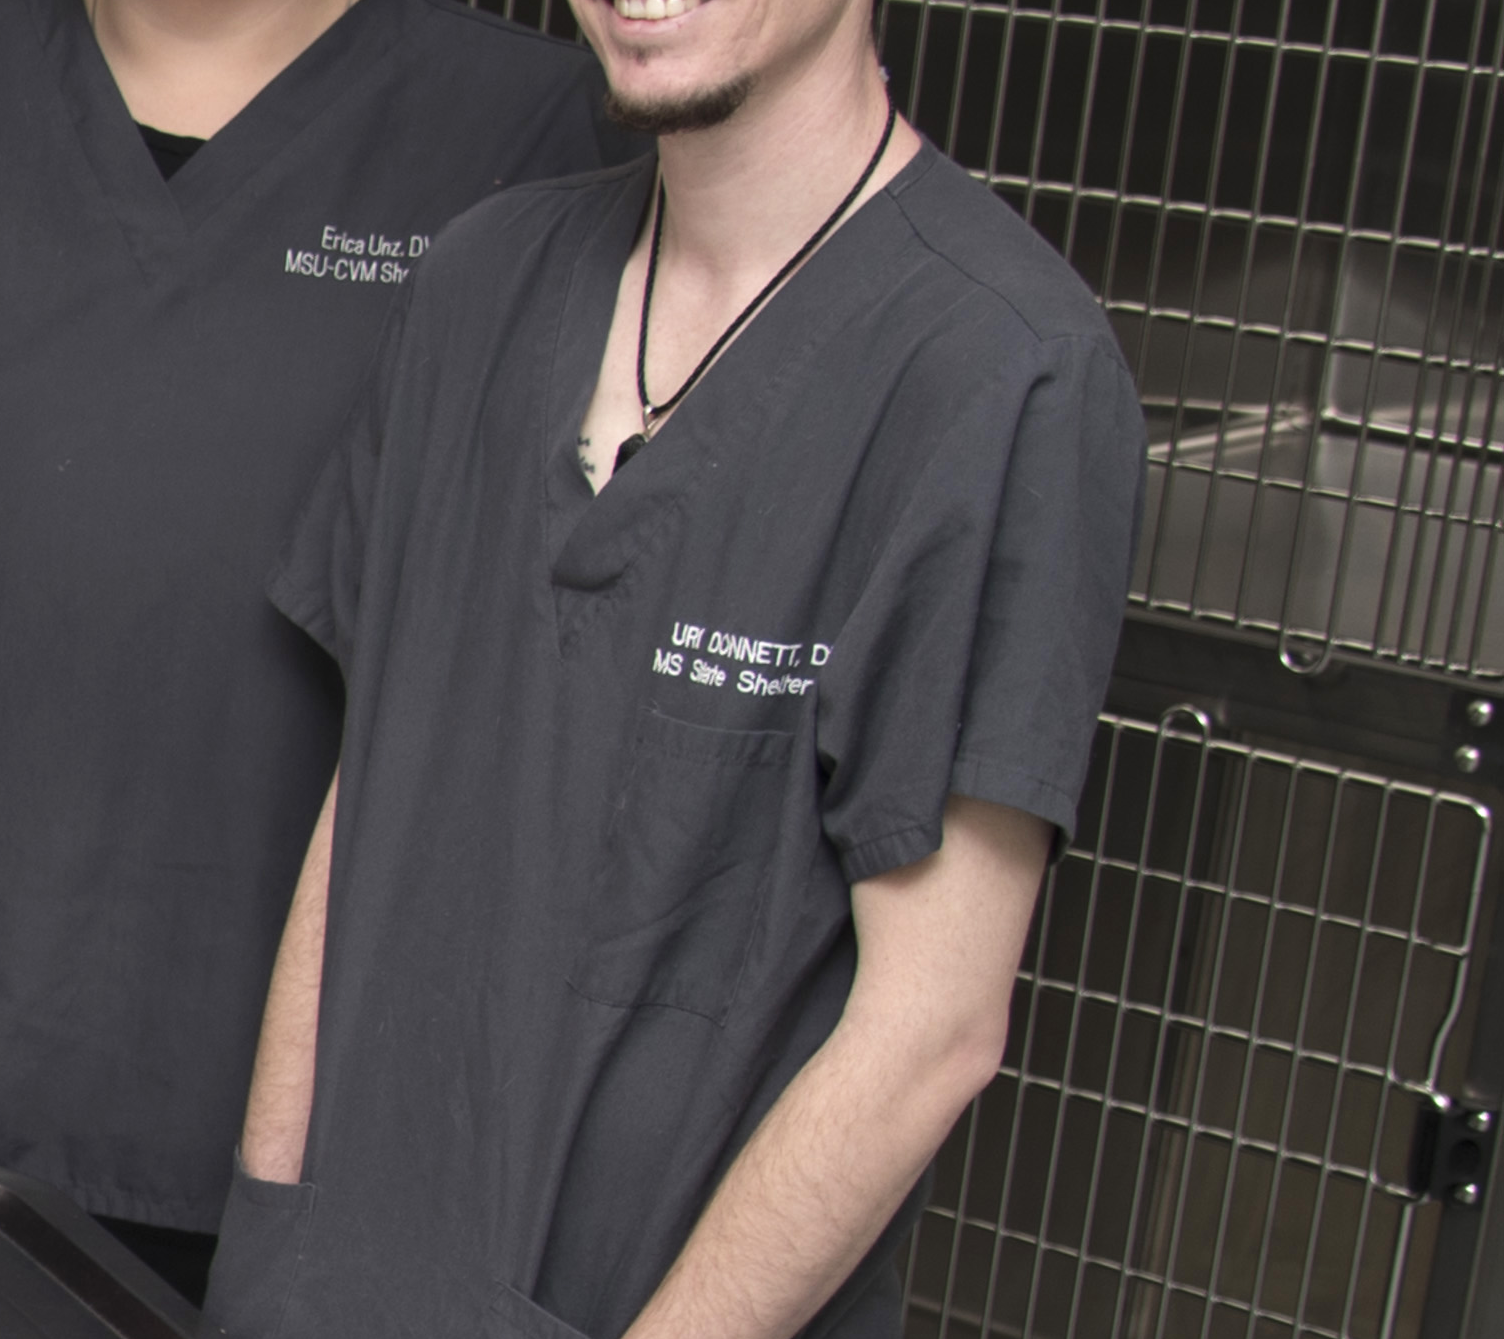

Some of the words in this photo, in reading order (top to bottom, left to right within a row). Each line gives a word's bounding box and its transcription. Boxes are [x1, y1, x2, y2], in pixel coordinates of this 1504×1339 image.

[321, 225, 365, 256] Erica
[284, 249, 378, 283] MSU-CVM
[671, 621, 706, 650] URI
[652, 647, 684, 676] MS
[735, 669, 815, 697] Shelter
